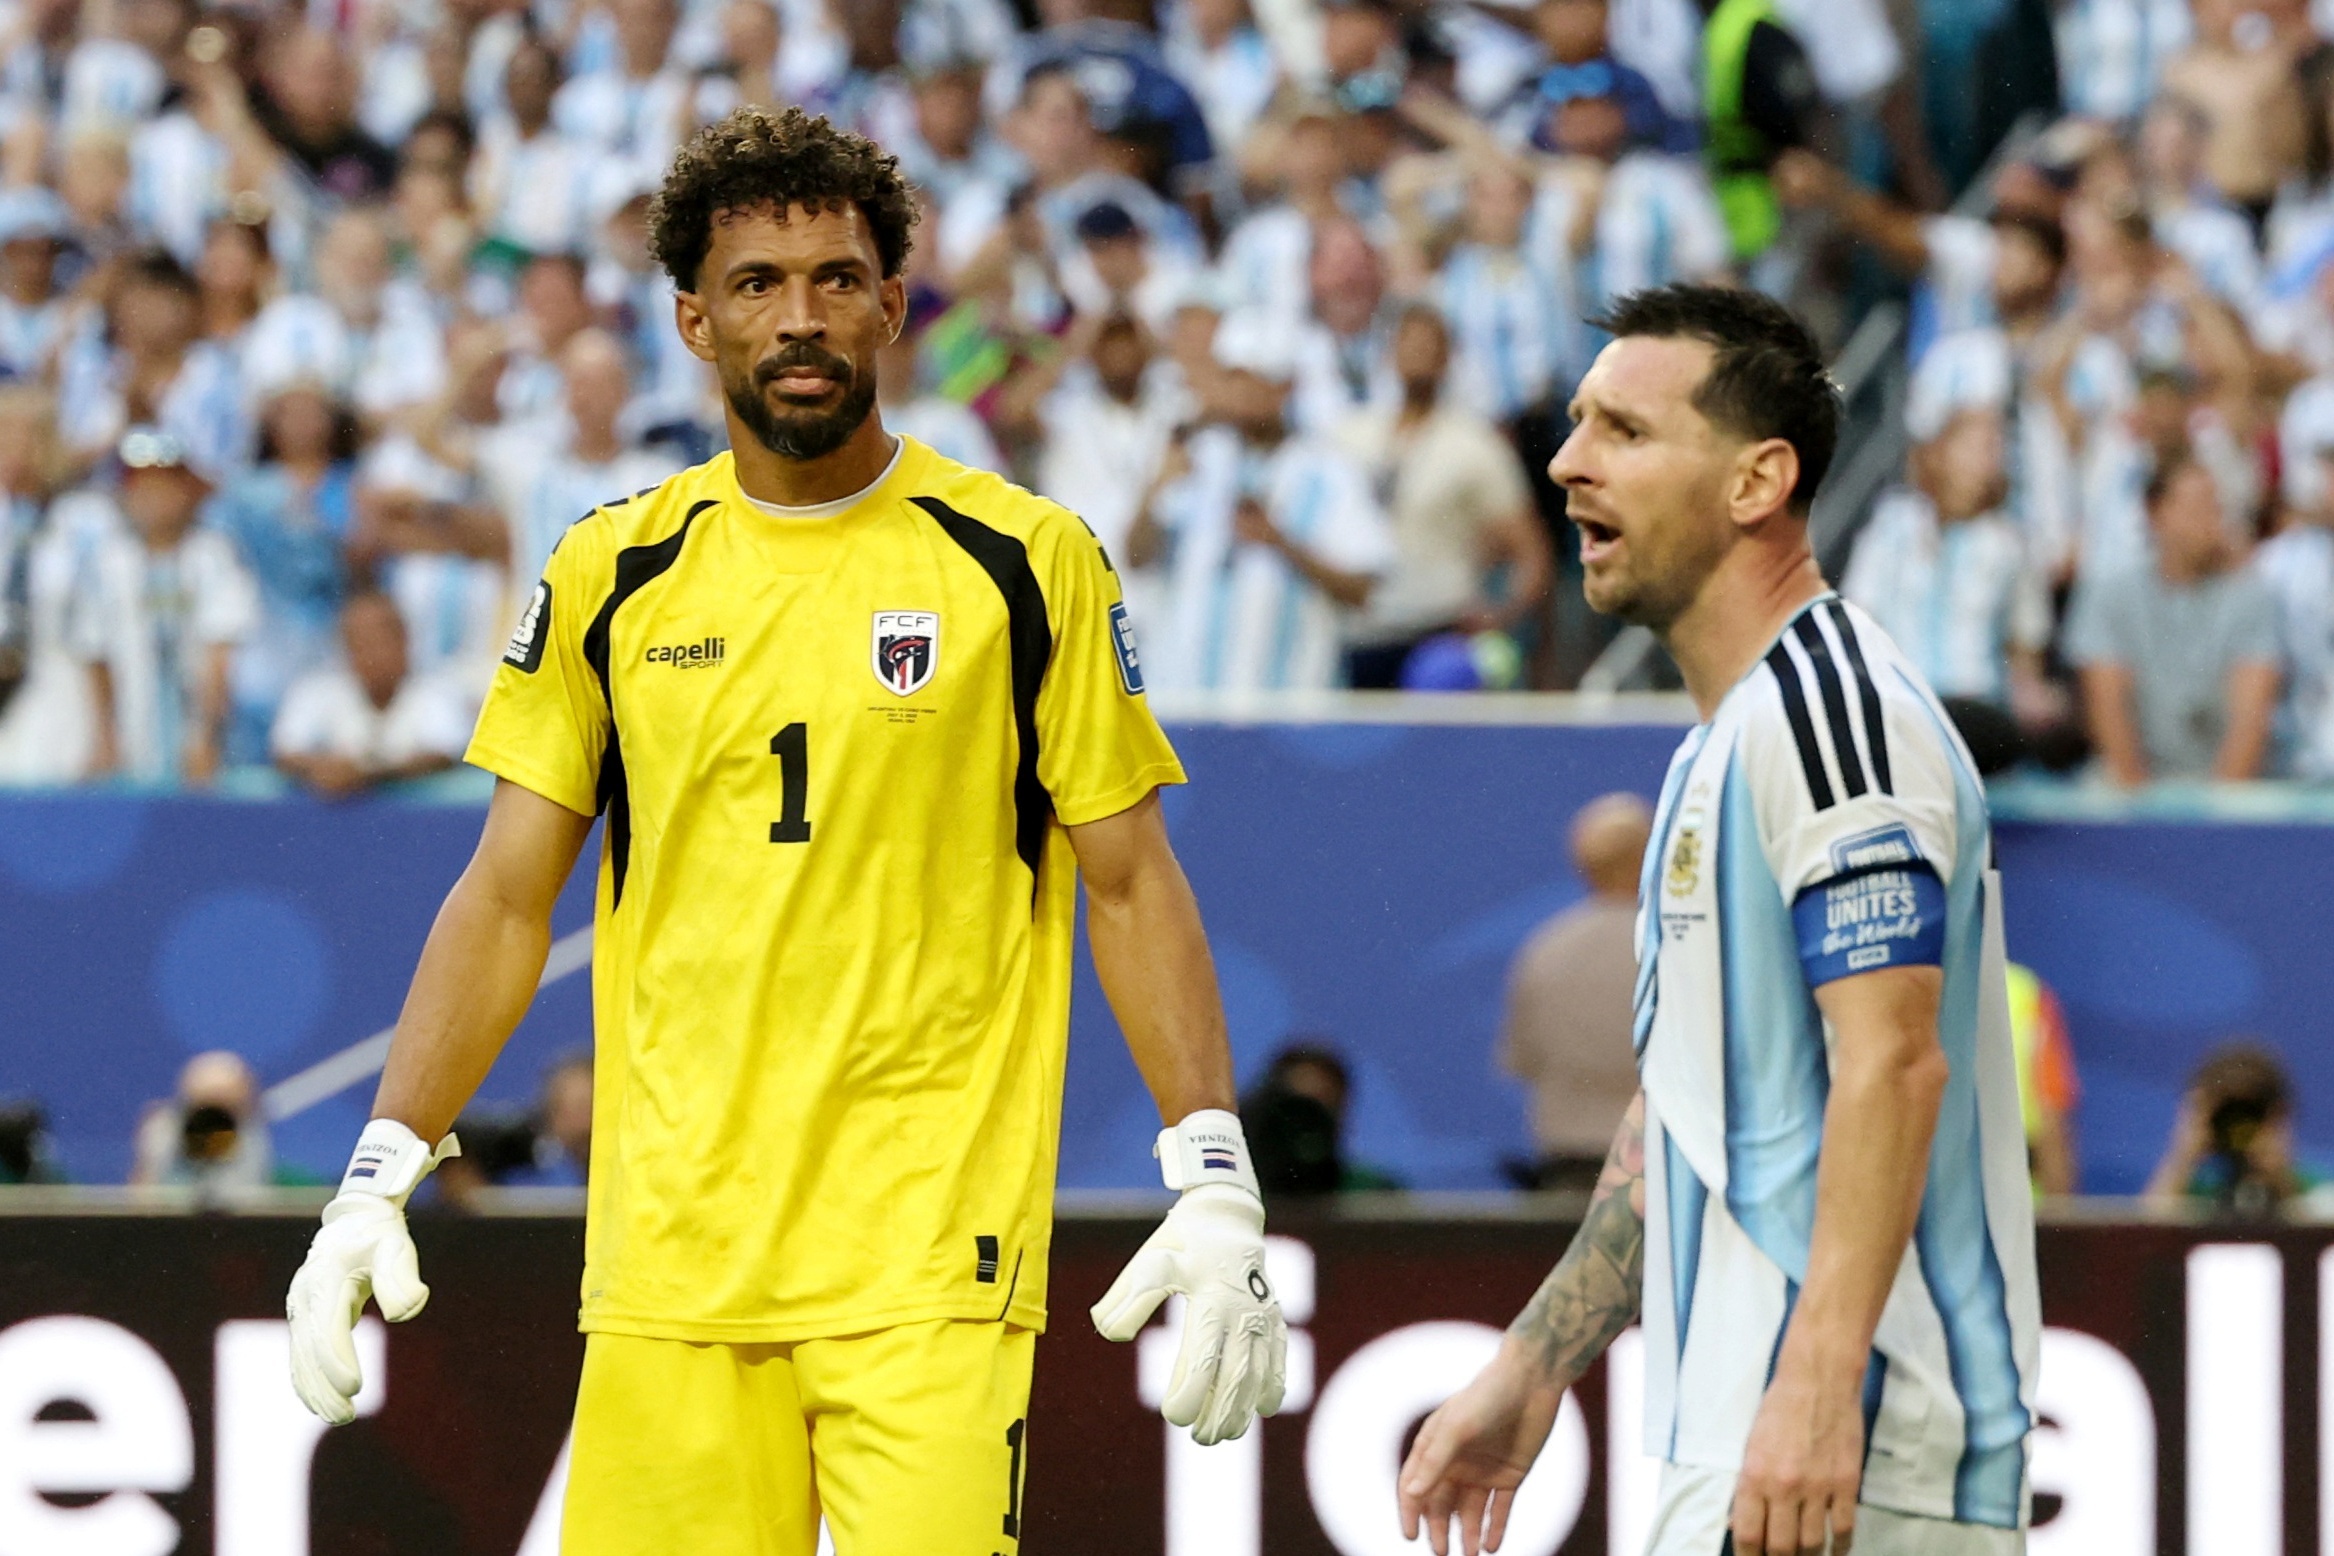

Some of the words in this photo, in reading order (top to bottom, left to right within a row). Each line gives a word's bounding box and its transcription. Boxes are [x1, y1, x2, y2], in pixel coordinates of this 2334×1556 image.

[879, 614, 933, 628] FCF
[645, 637, 726, 667] capelli
[679, 659, 724, 670] SPORT
[769, 722, 811, 843] 1
[1826, 889, 1917, 931] UNITES
